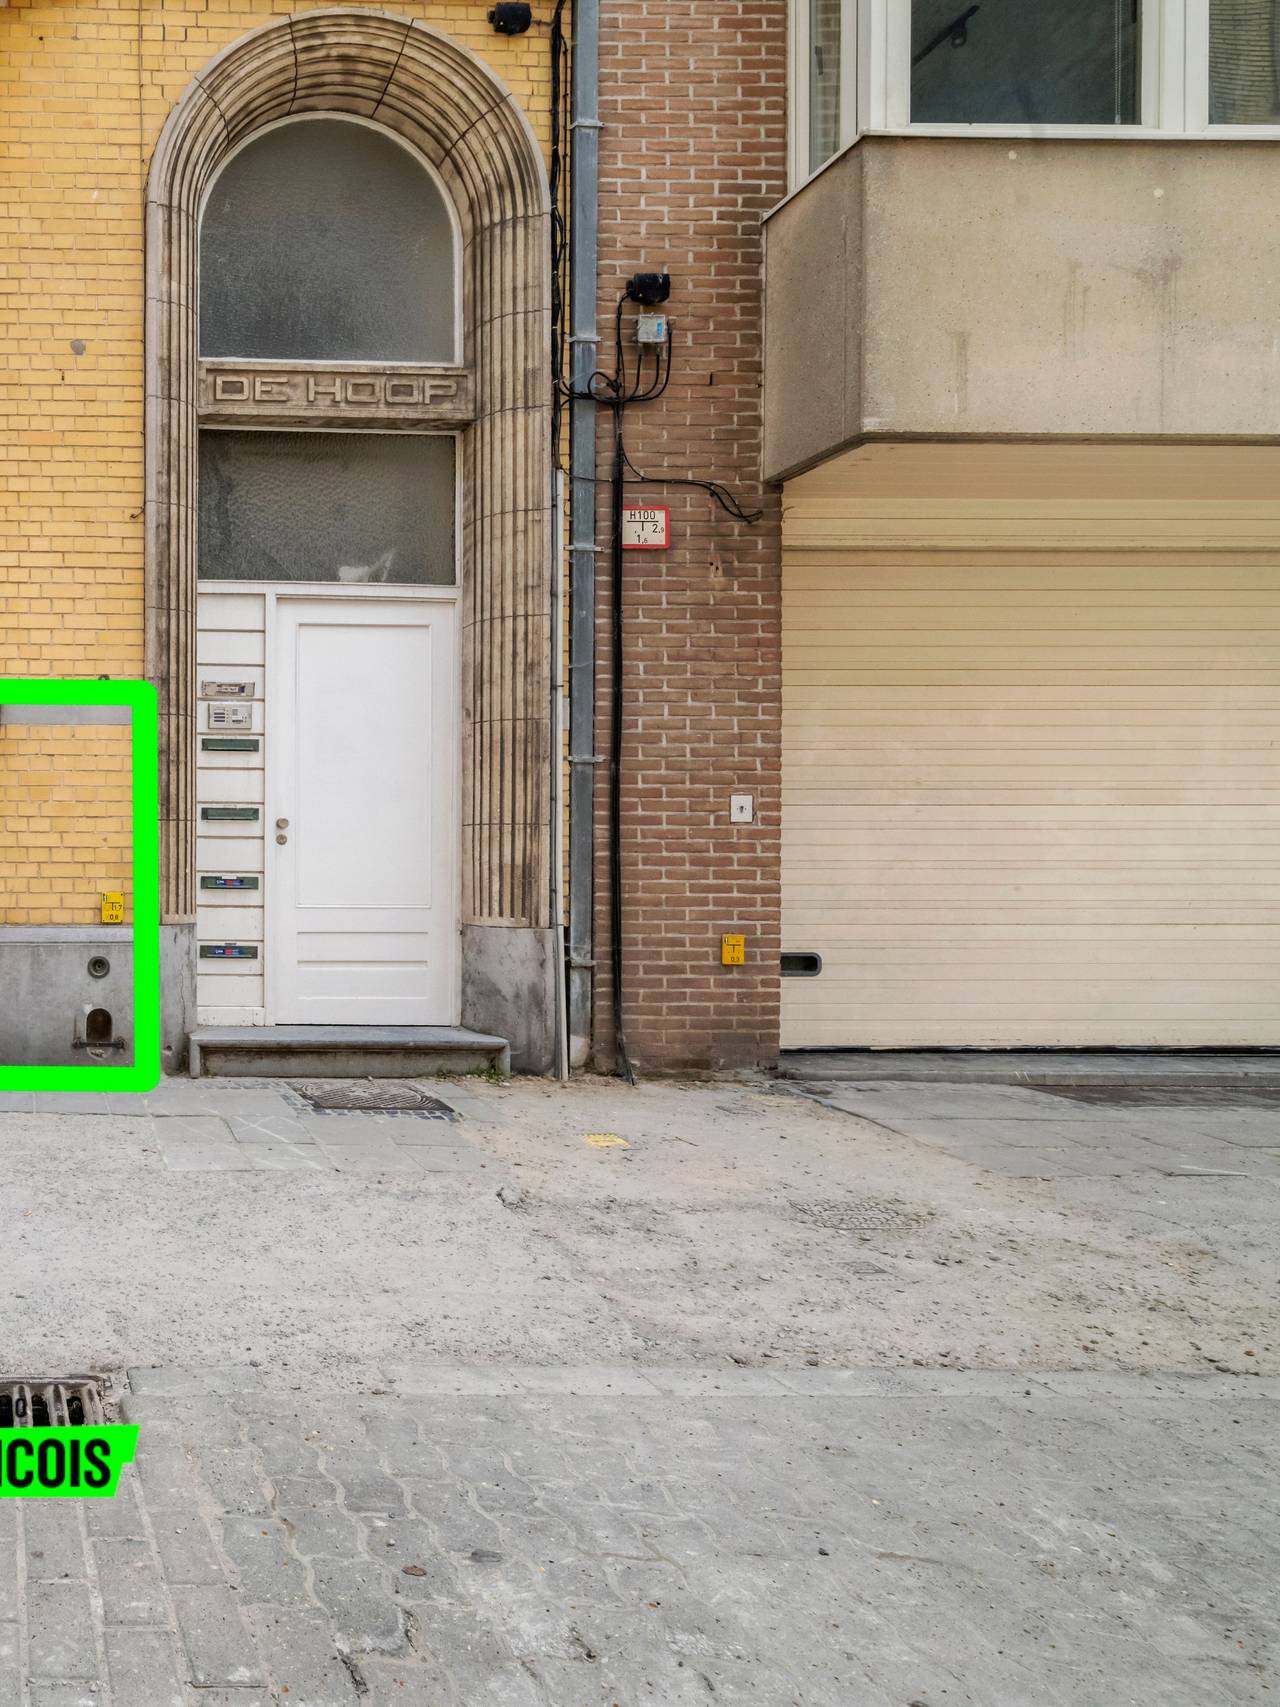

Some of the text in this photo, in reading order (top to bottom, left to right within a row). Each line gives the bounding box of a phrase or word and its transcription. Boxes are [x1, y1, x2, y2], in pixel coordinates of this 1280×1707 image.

[214, 375, 458, 405] DE HOOP
[629, 510, 656, 520] H100
